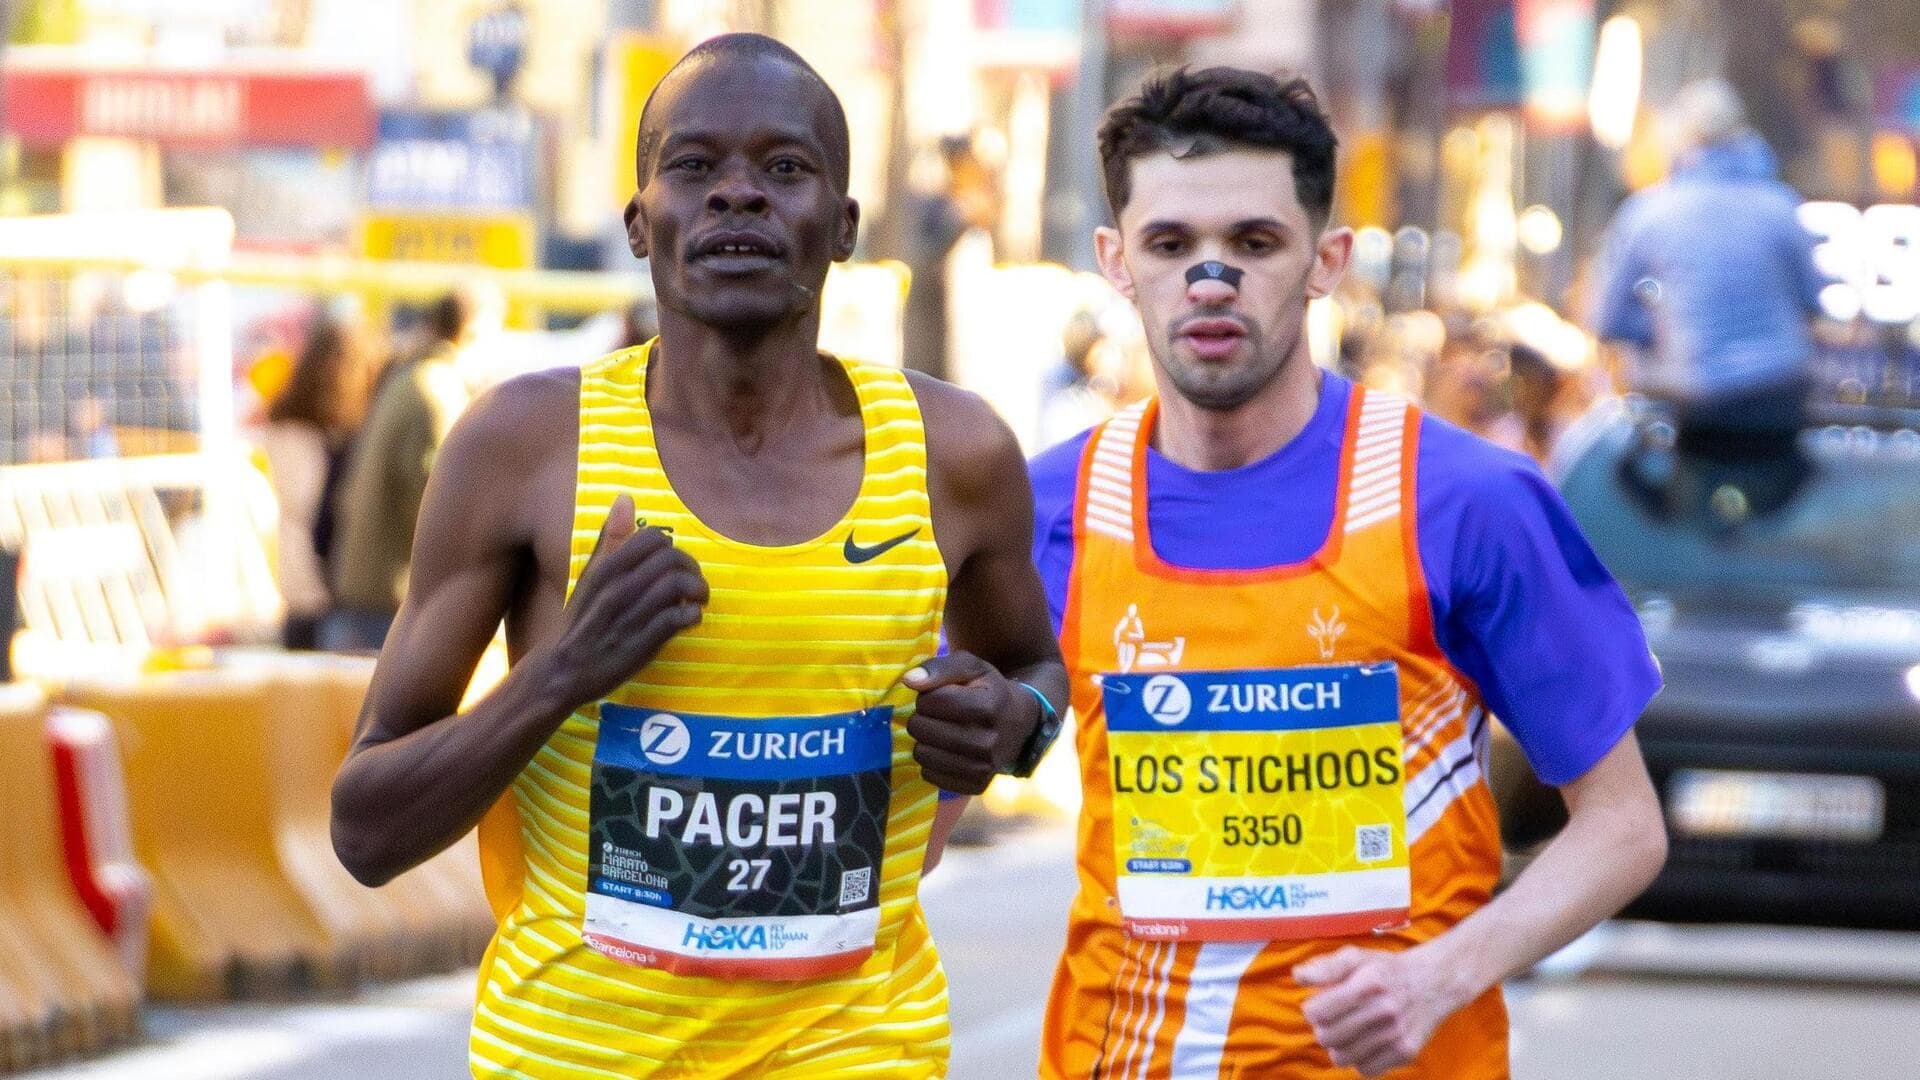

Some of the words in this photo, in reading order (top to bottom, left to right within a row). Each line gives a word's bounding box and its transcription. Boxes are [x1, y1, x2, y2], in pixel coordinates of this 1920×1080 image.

[1206, 682, 1342, 713] ZURICH
[707, 728, 846, 760] ZURICH
[1113, 754, 1184, 794] LOS
[1197, 747, 1400, 794] STICHOOS
[646, 786, 838, 848] PACER
[1223, 813, 1303, 847] 5350
[602, 863, 669, 889] BARCELONA
[602, 881, 633, 895] START
[726, 858, 773, 891] 27
[1205, 885, 1288, 911] HOKA
[682, 922, 767, 949] HOKA
